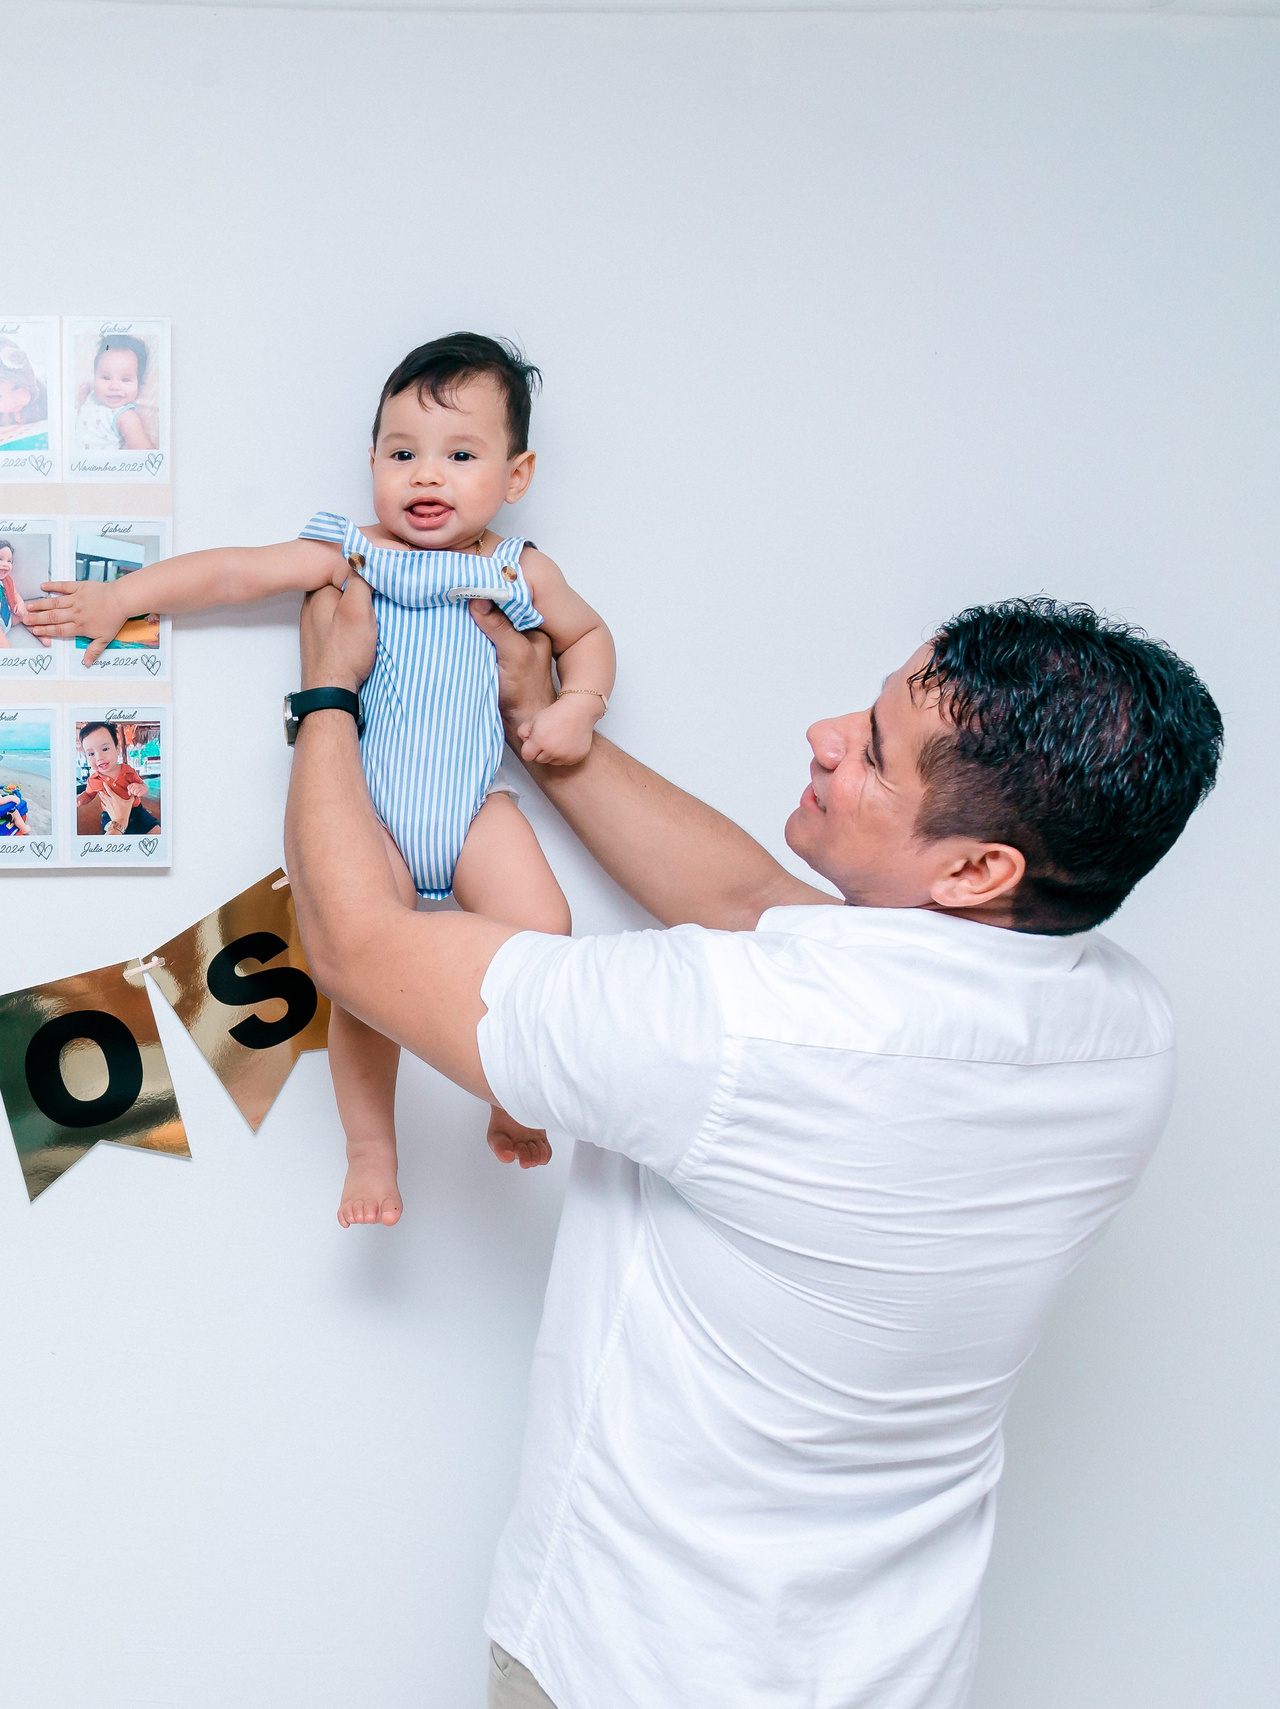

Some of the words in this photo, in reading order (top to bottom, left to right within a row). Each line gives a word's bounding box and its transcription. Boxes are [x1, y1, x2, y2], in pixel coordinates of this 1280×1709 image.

[99, 322, 132, 337] Gabriel
[0, 458, 27, 467] 2023
[70, 460, 117, 472] Noviembre
[118, 463, 145, 471] 2023
[100, 522, 132, 537] Gabriel
[0, 658, 27, 666] 2024
[112, 656, 139, 666] 2024
[104, 709, 137, 724] Gabriel
[0, 845, 25, 854] 2024
[80, 842, 104, 857] Julio
[105, 844, 131, 853] 2024
